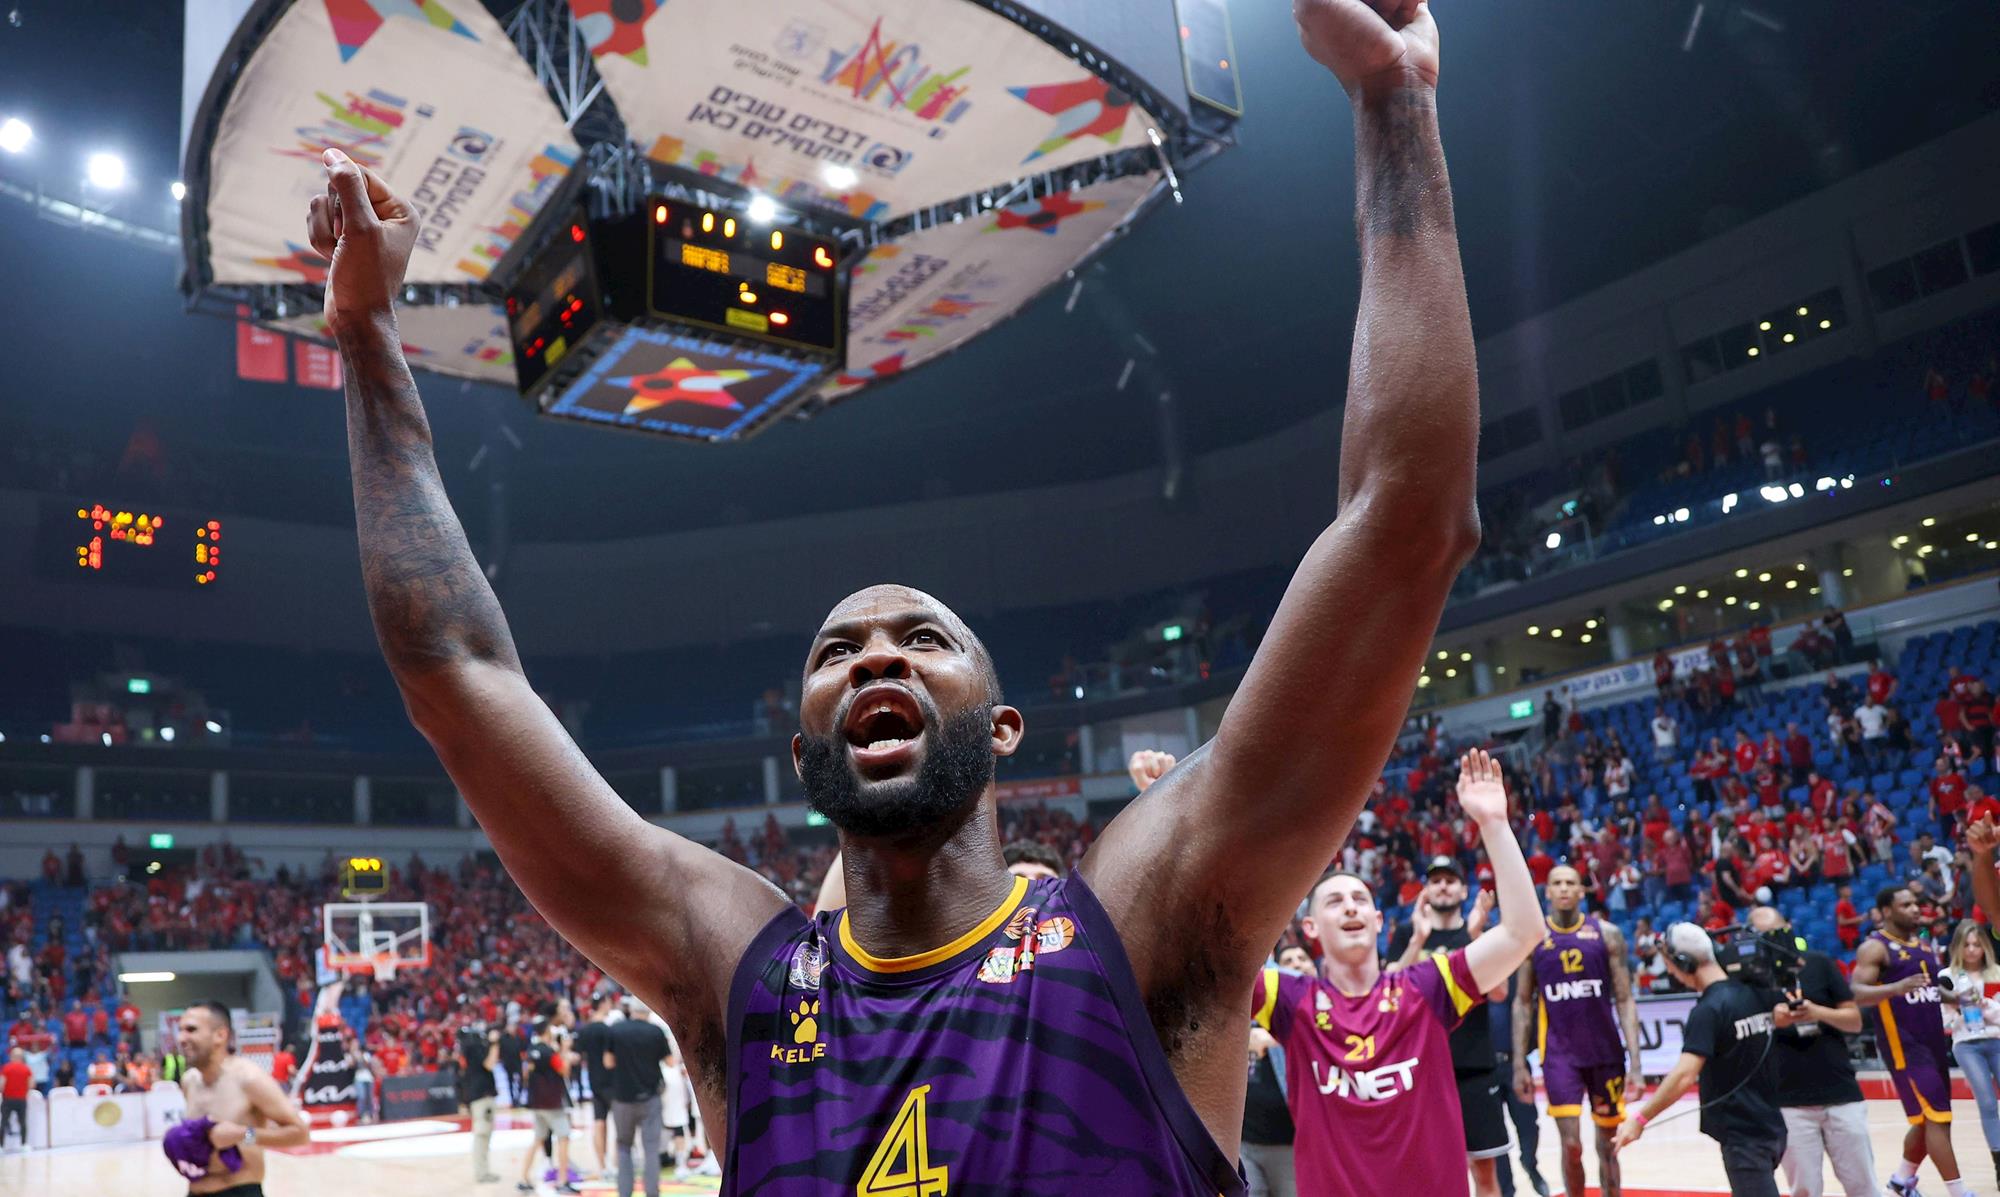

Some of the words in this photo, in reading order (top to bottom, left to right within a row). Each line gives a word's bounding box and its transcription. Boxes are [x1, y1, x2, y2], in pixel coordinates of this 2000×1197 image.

[686, 102, 739, 131] כאן
[708, 84, 788, 123] טובים
[742, 119, 854, 164] מתחילים
[788, 111, 868, 150] דברים
[1559, 948, 1585, 975] 12
[1545, 979, 1603, 1002] UNET
[1905, 985, 1941, 1005] UNE
[770, 1042, 827, 1064] KELE
[1344, 1034, 1376, 1061] 21
[1312, 1057, 1419, 1100] UNET
[856, 1083, 949, 1197] 4
